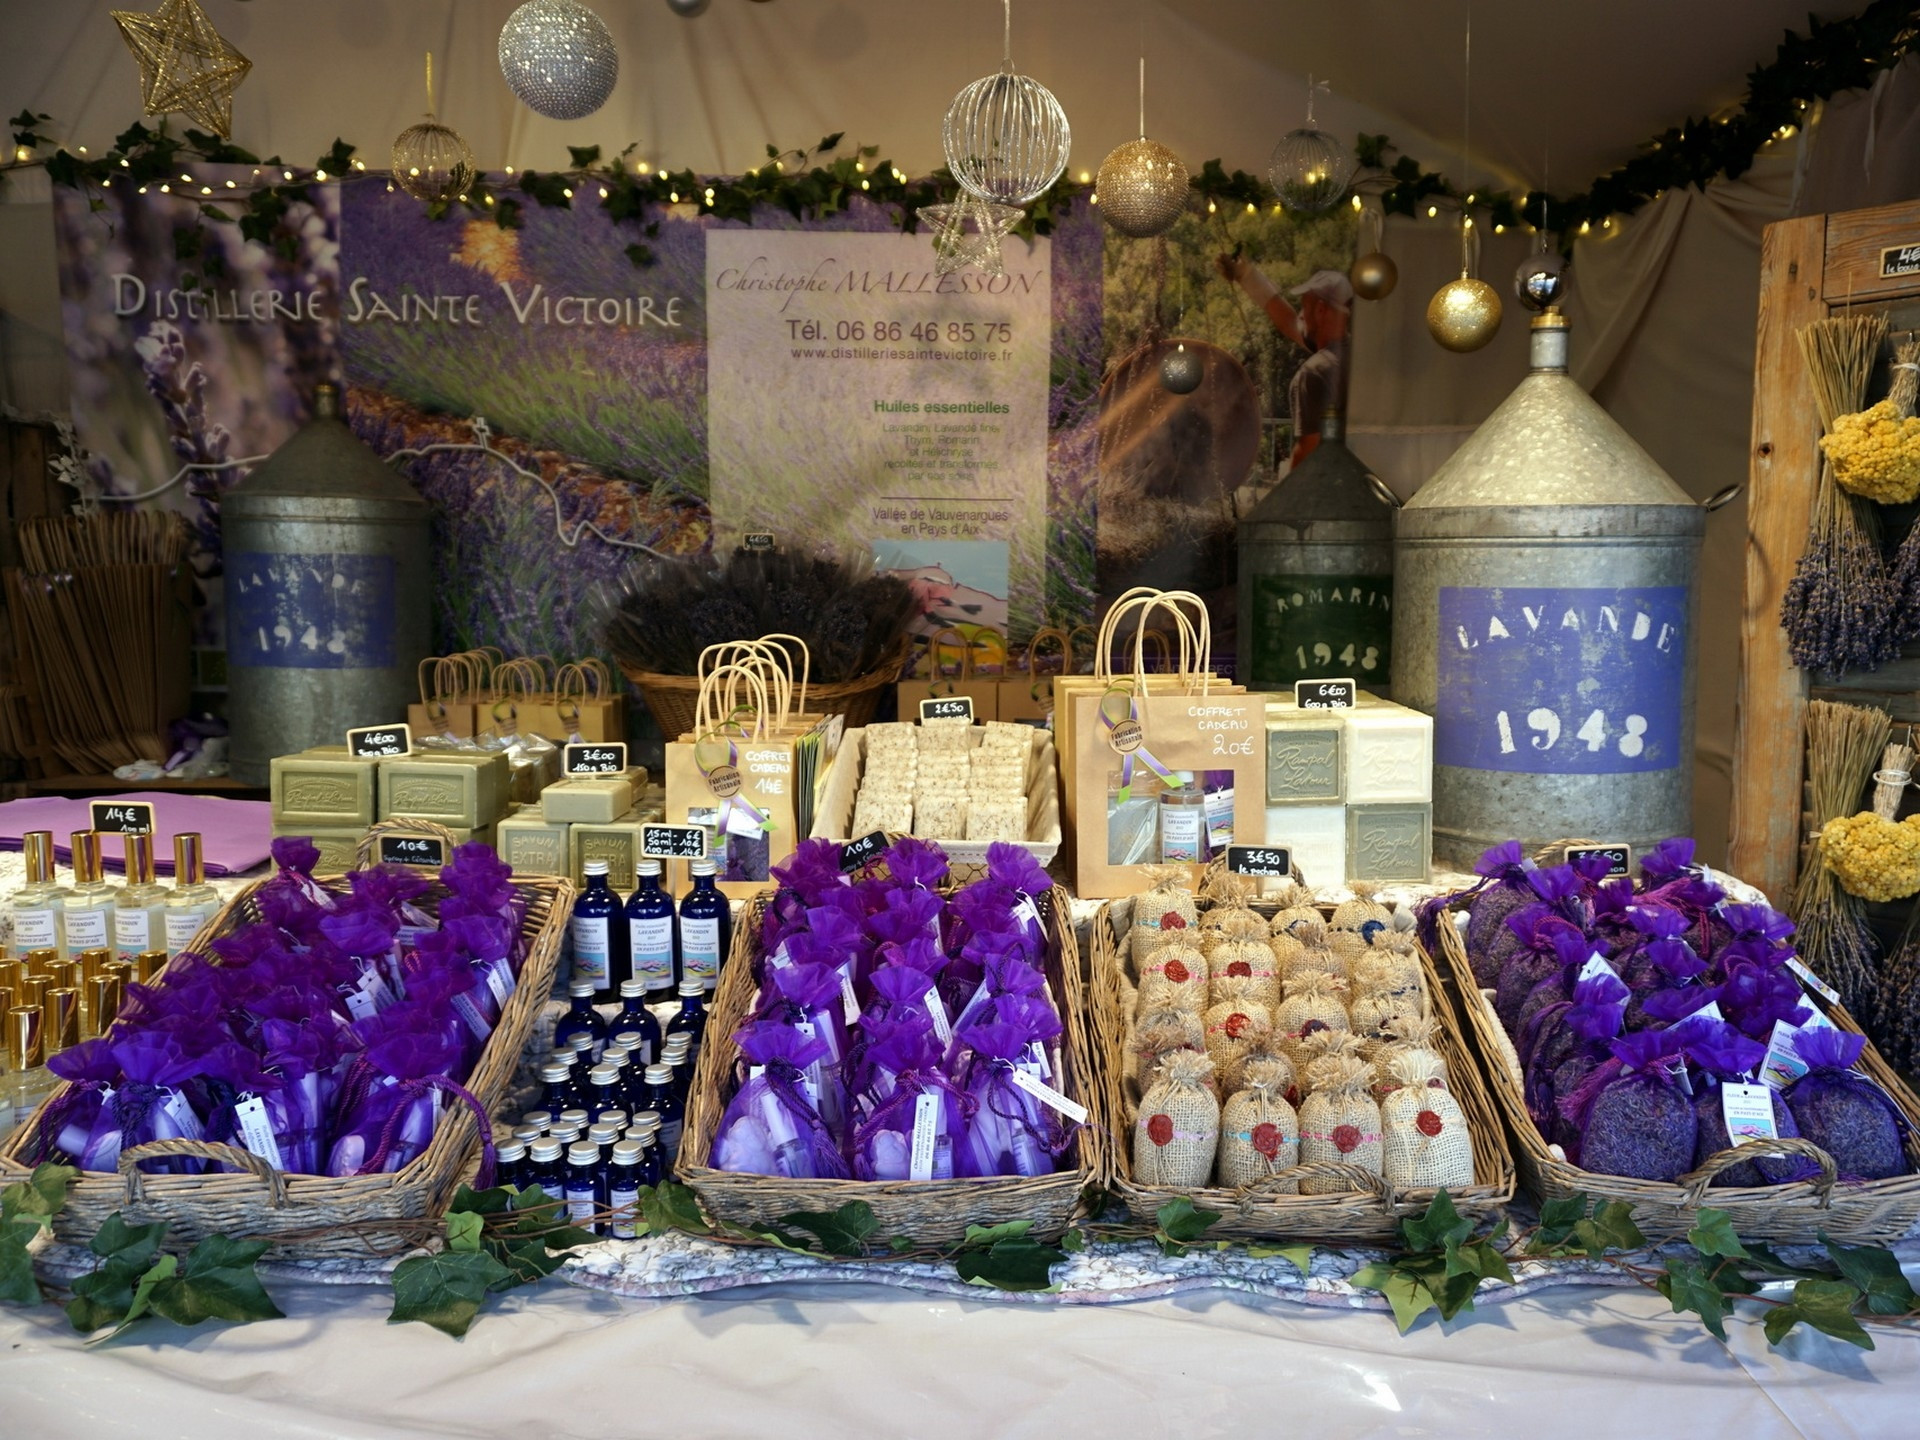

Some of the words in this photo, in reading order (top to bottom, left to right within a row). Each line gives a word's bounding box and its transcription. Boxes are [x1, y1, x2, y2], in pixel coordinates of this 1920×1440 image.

[716, 255, 836, 313] Christophe
[835, 270, 1044, 295] MALLESSON
[785, 319, 827, 341] Tél.
[836, 320, 865, 341] 06
[873, 321, 902, 342] 86
[910, 322, 939, 342] 46
[946, 322, 976, 343] 85
[984, 322, 1012, 343] 75
[791, 347, 1013, 362] www.distilleriesaintevictoire.fr
[874, 399, 920, 413] Huiles
[924, 400, 1010, 414] essentielles
[872, 507, 907, 522] Vallée
[910, 508, 925, 521] de
[928, 509, 1009, 525] Vauvenargues
[901, 524, 915, 535] en
[919, 523, 948, 537] Pays
[1457, 604, 1680, 654] LAVANDE
[1295, 642, 1380, 671] 1948
[935, 702, 964, 714] 2€50
[1188, 706, 1247, 717] COFFRET
[1198, 719, 1249, 730] CADEAU
[364, 732, 397, 745] 4€00
[1496, 707, 1648, 758] 1948
[1212, 733, 1255, 755] 20€
[745, 750, 792, 763] COFFRET
[755, 777, 784, 794] 14€
[105, 807, 137, 823] 14€
[396, 840, 429, 851] 10€
[583, 837, 627, 850] SAVON
[845, 837, 874, 857] 10€
[511, 851, 554, 866] EXTRA
[1246, 850, 1280, 866] 3€50
[1238, 863, 1249, 875] le
